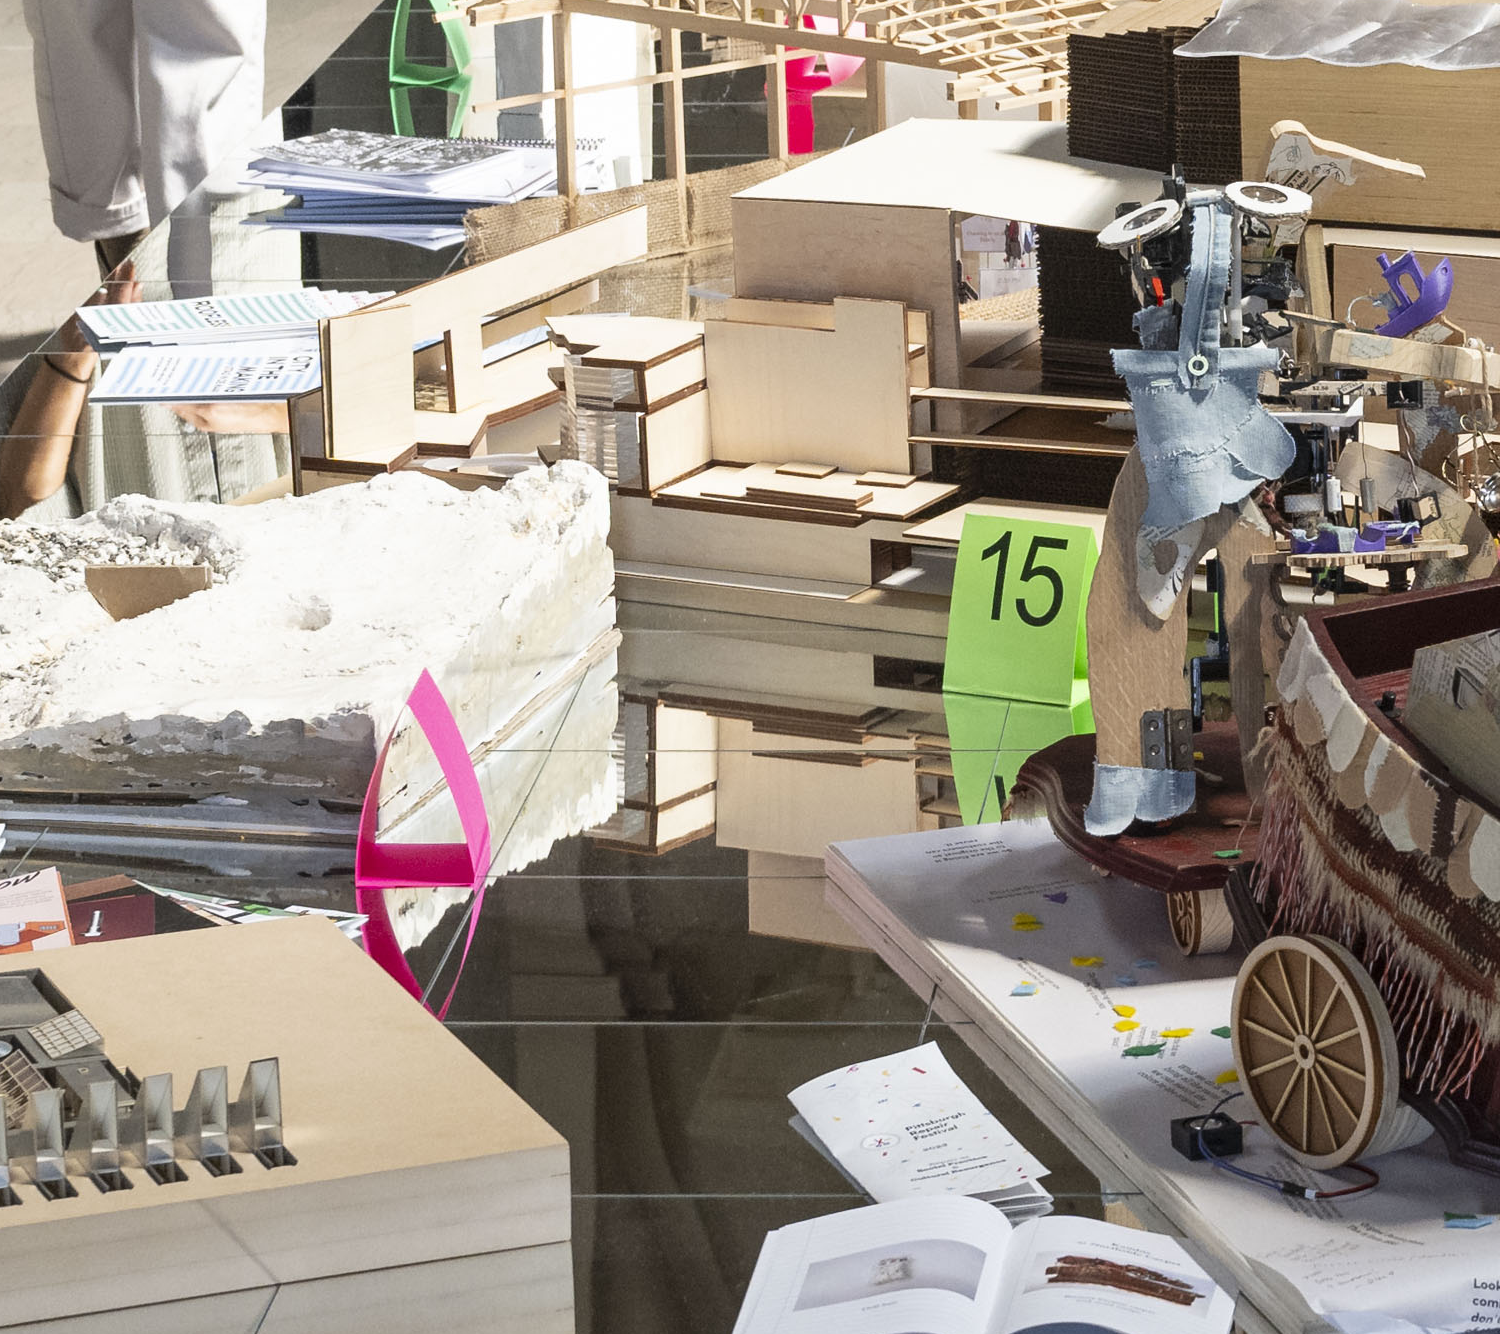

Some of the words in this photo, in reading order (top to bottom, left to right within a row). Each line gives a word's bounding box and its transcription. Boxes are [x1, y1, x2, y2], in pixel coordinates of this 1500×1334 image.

[981, 530, 1069, 627] 15
[904, 1111, 966, 1131] Pittsburgh
[1471, 1312, 1500, 1324] don't
